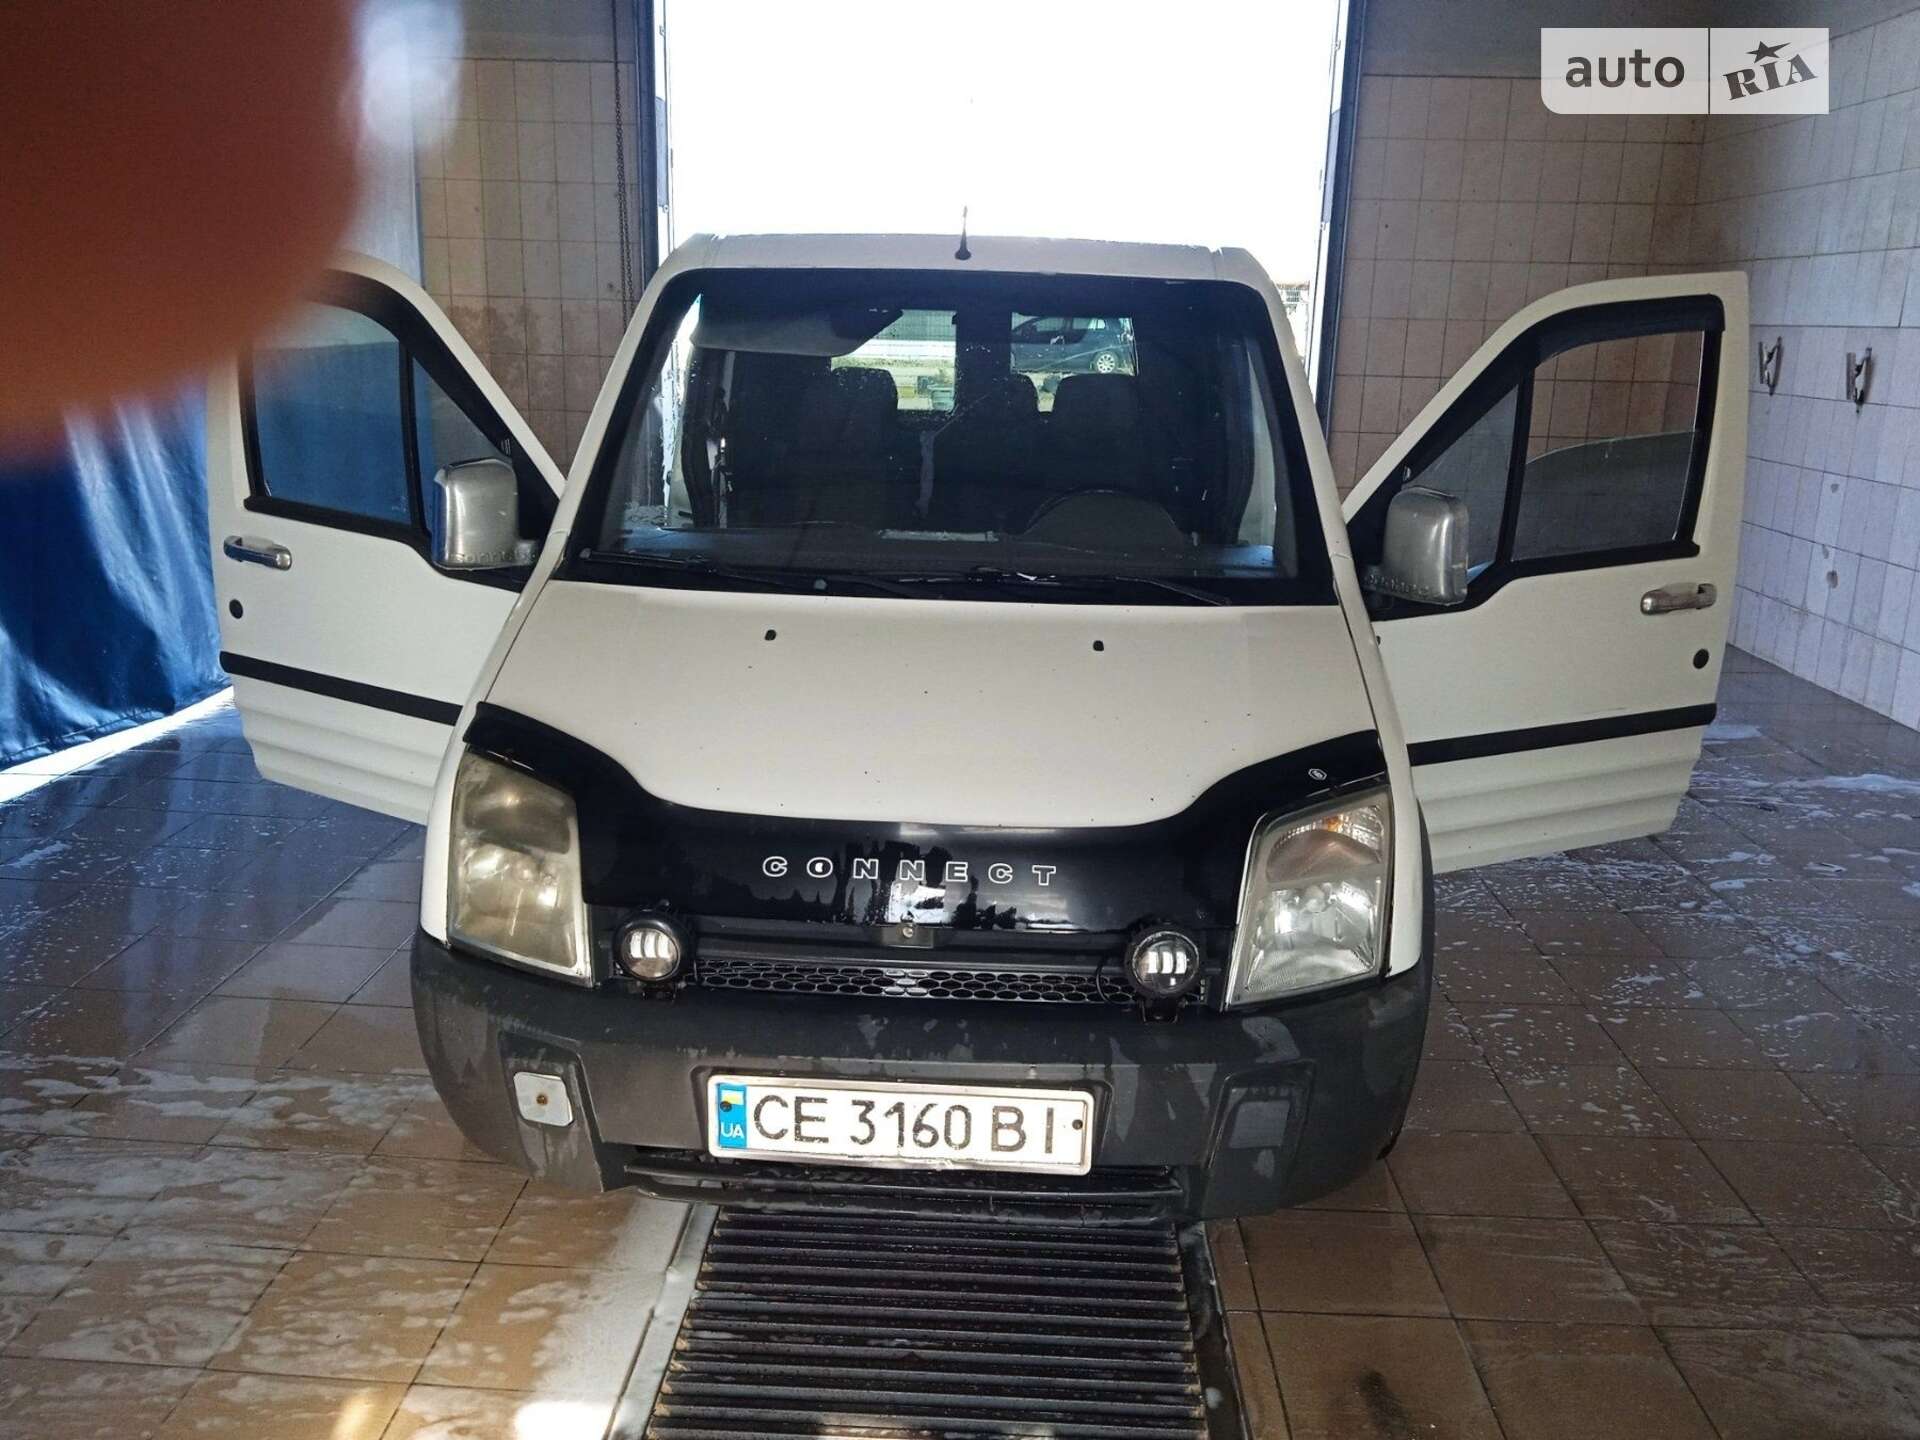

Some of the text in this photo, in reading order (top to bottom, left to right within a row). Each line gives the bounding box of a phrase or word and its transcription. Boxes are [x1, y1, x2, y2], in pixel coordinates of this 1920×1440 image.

[762, 856, 1056, 885] CONNECT
[720, 1121, 745, 1139] UA
[753, 1094, 1054, 1154] CE 3160 BI
